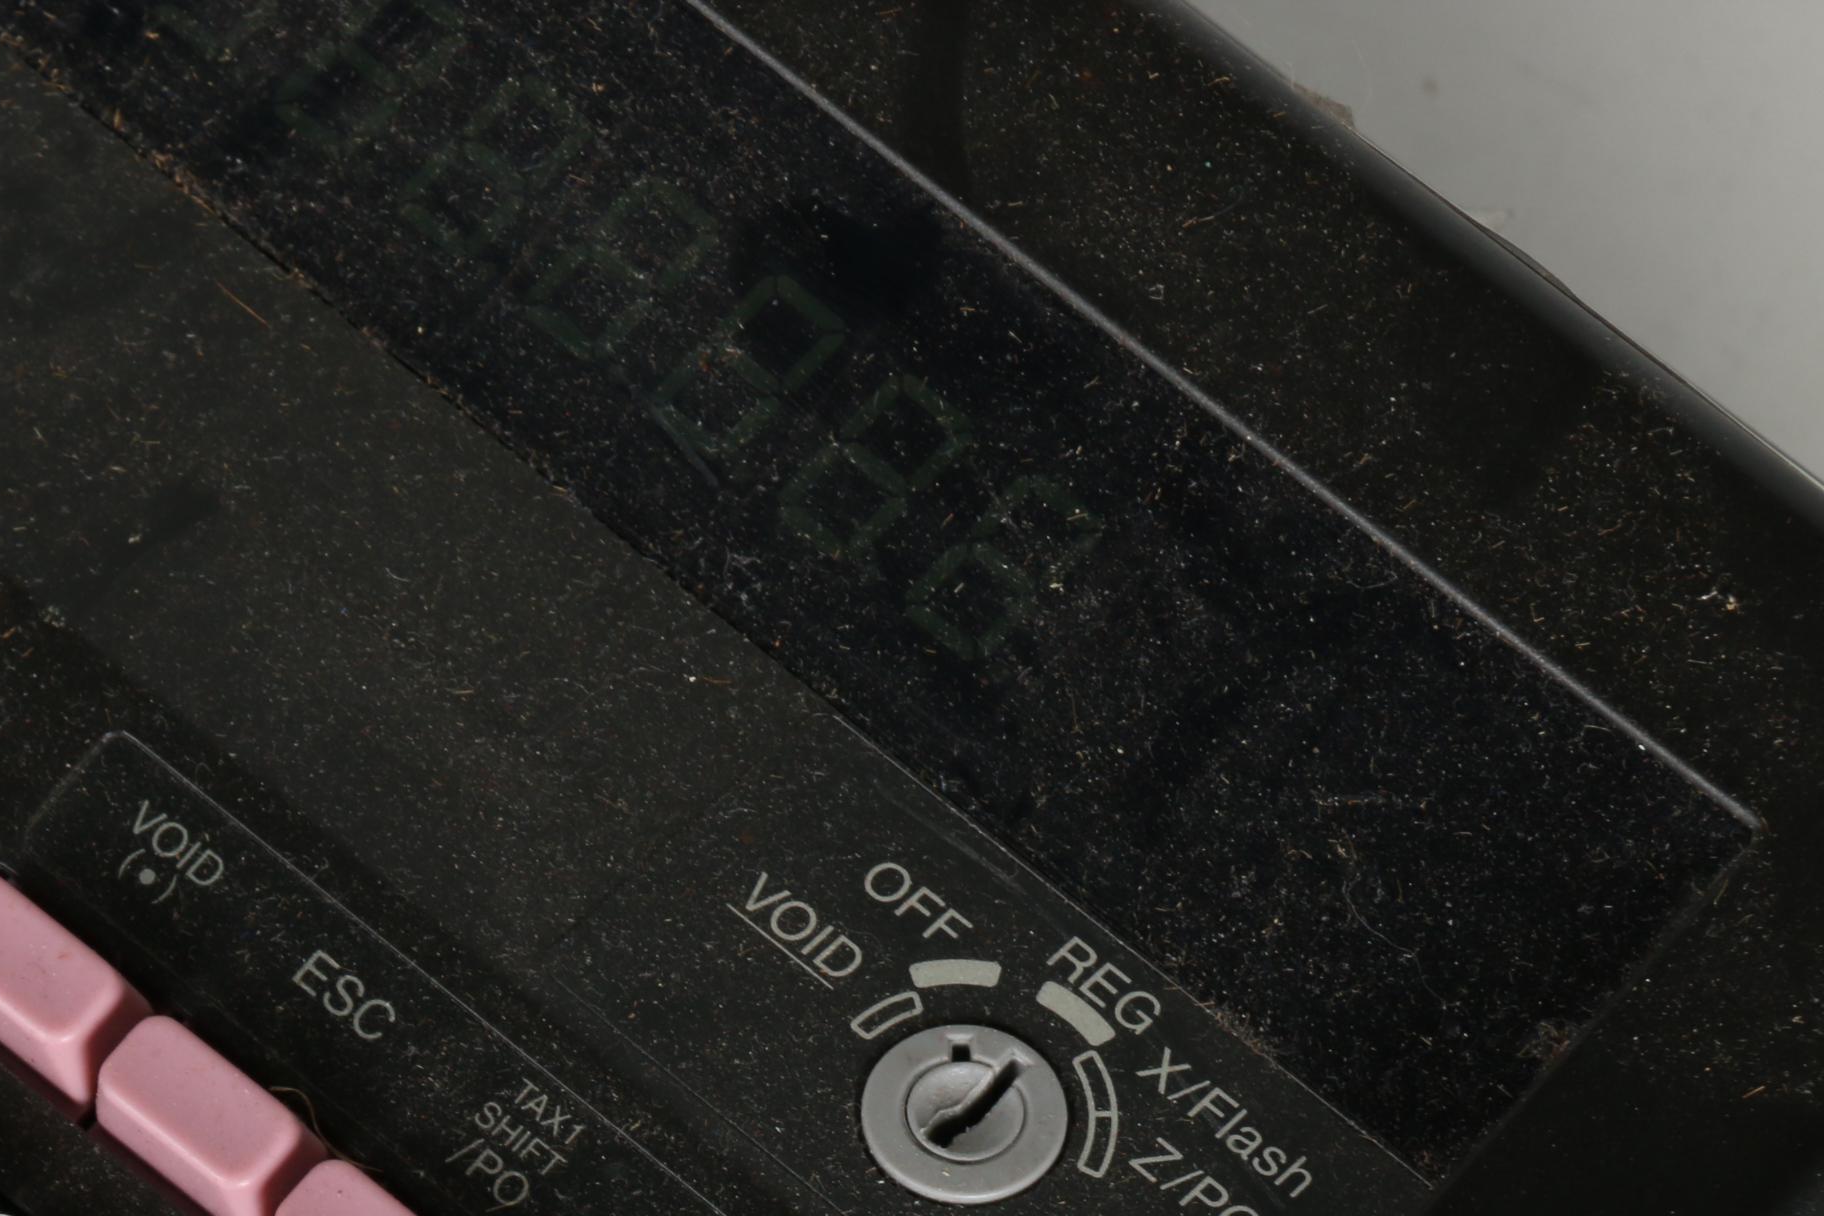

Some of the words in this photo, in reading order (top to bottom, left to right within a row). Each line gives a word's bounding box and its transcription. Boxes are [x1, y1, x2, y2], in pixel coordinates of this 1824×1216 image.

[131, 800, 225, 887] VOID
[742, 871, 864, 979] VOID
[864, 862, 973, 939] OFF
[292, 949, 396, 1041] ESC
[1046, 936, 1162, 1034] REG
[475, 1101, 568, 1176] SHIFT
[513, 1077, 585, 1146] TAX1
[1135, 1048, 1315, 1198] X/Flash
